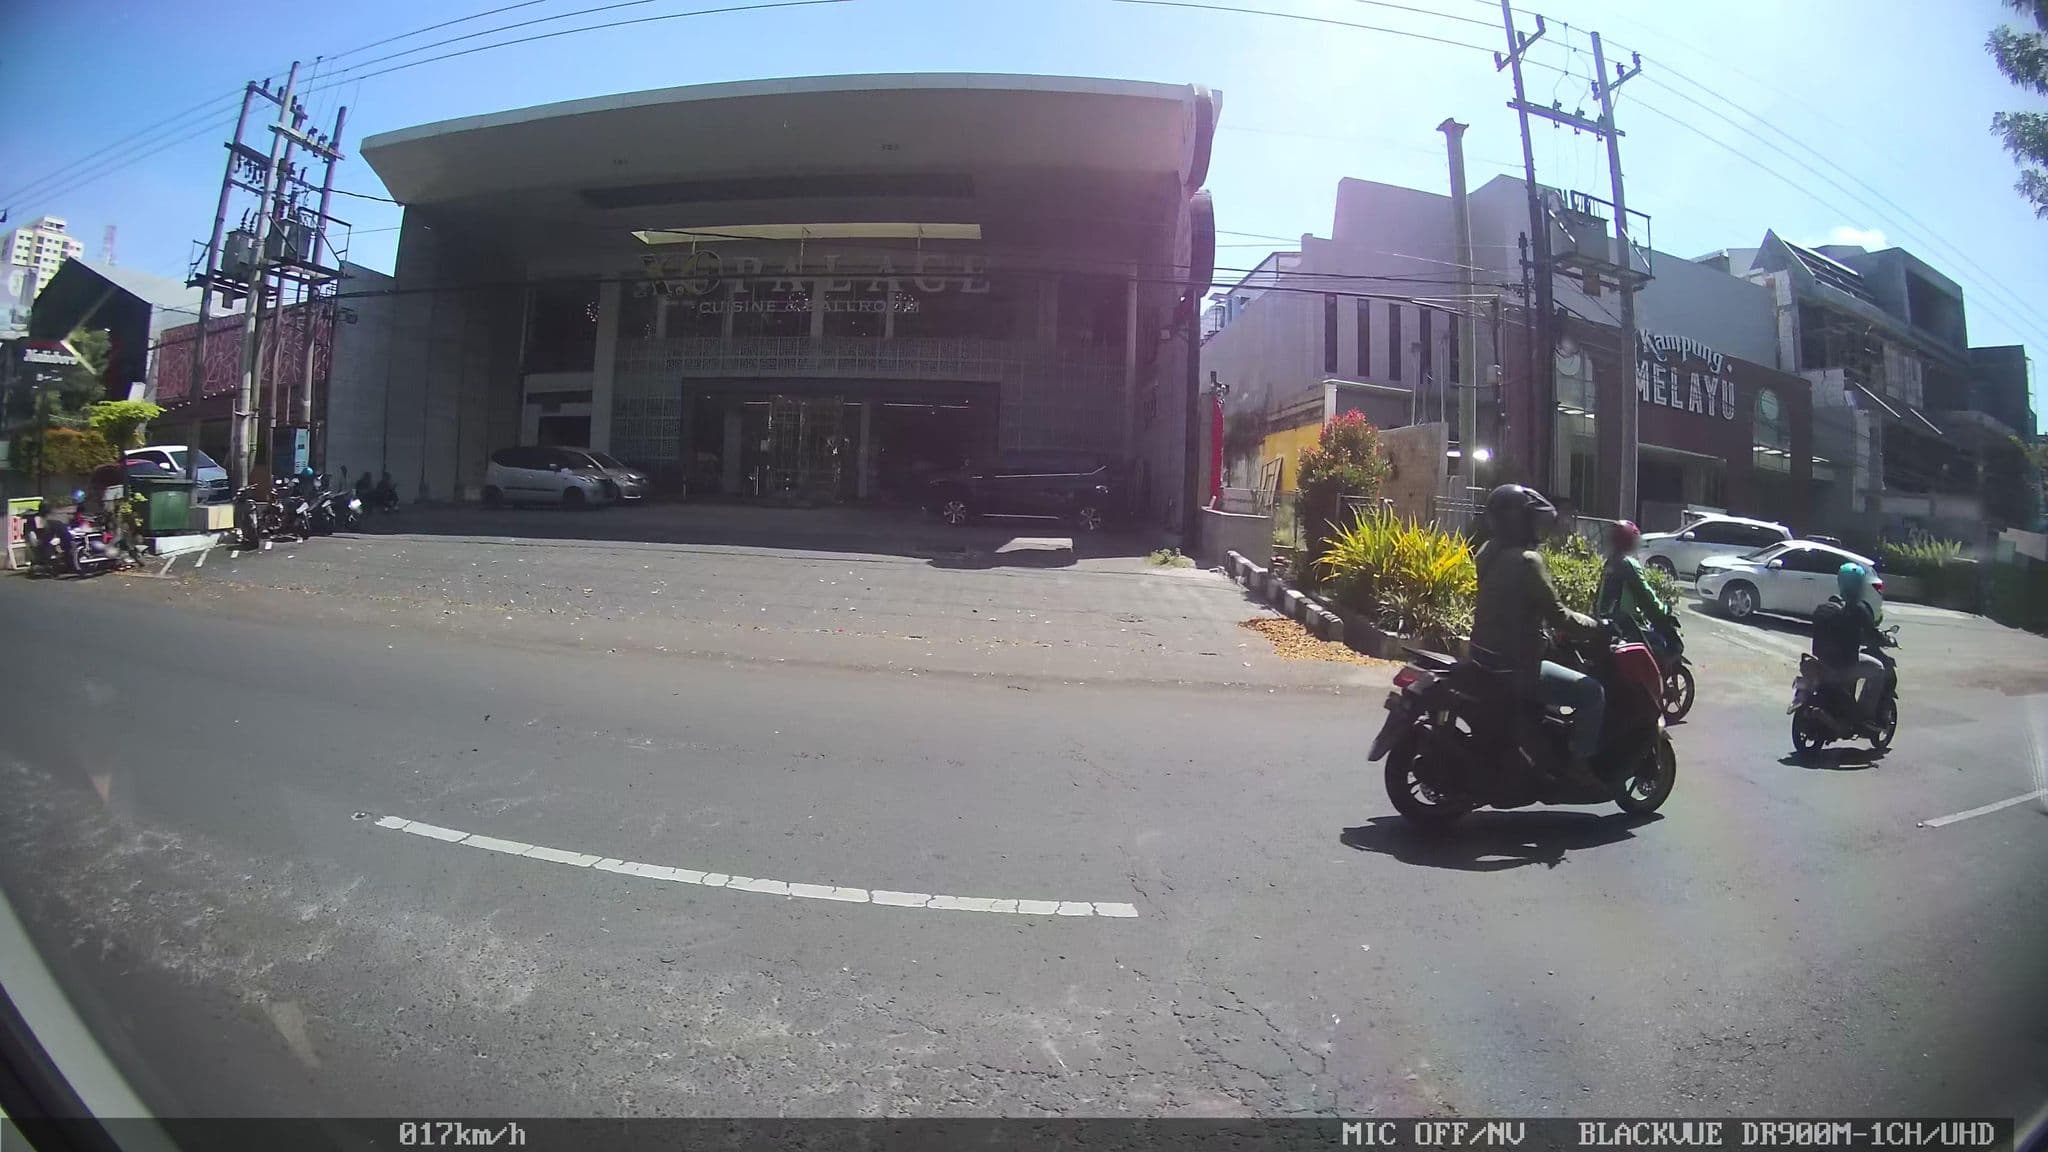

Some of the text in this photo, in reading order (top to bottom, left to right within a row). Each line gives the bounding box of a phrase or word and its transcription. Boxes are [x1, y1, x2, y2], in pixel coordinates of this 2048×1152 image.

[735, 254, 990, 294] PALACE
[700, 300, 777, 313] CUISINE
[804, 300, 920, 313] BALLROM
[1635, 328, 1724, 374] Kampung
[1635, 360, 1735, 420] MELAYU
